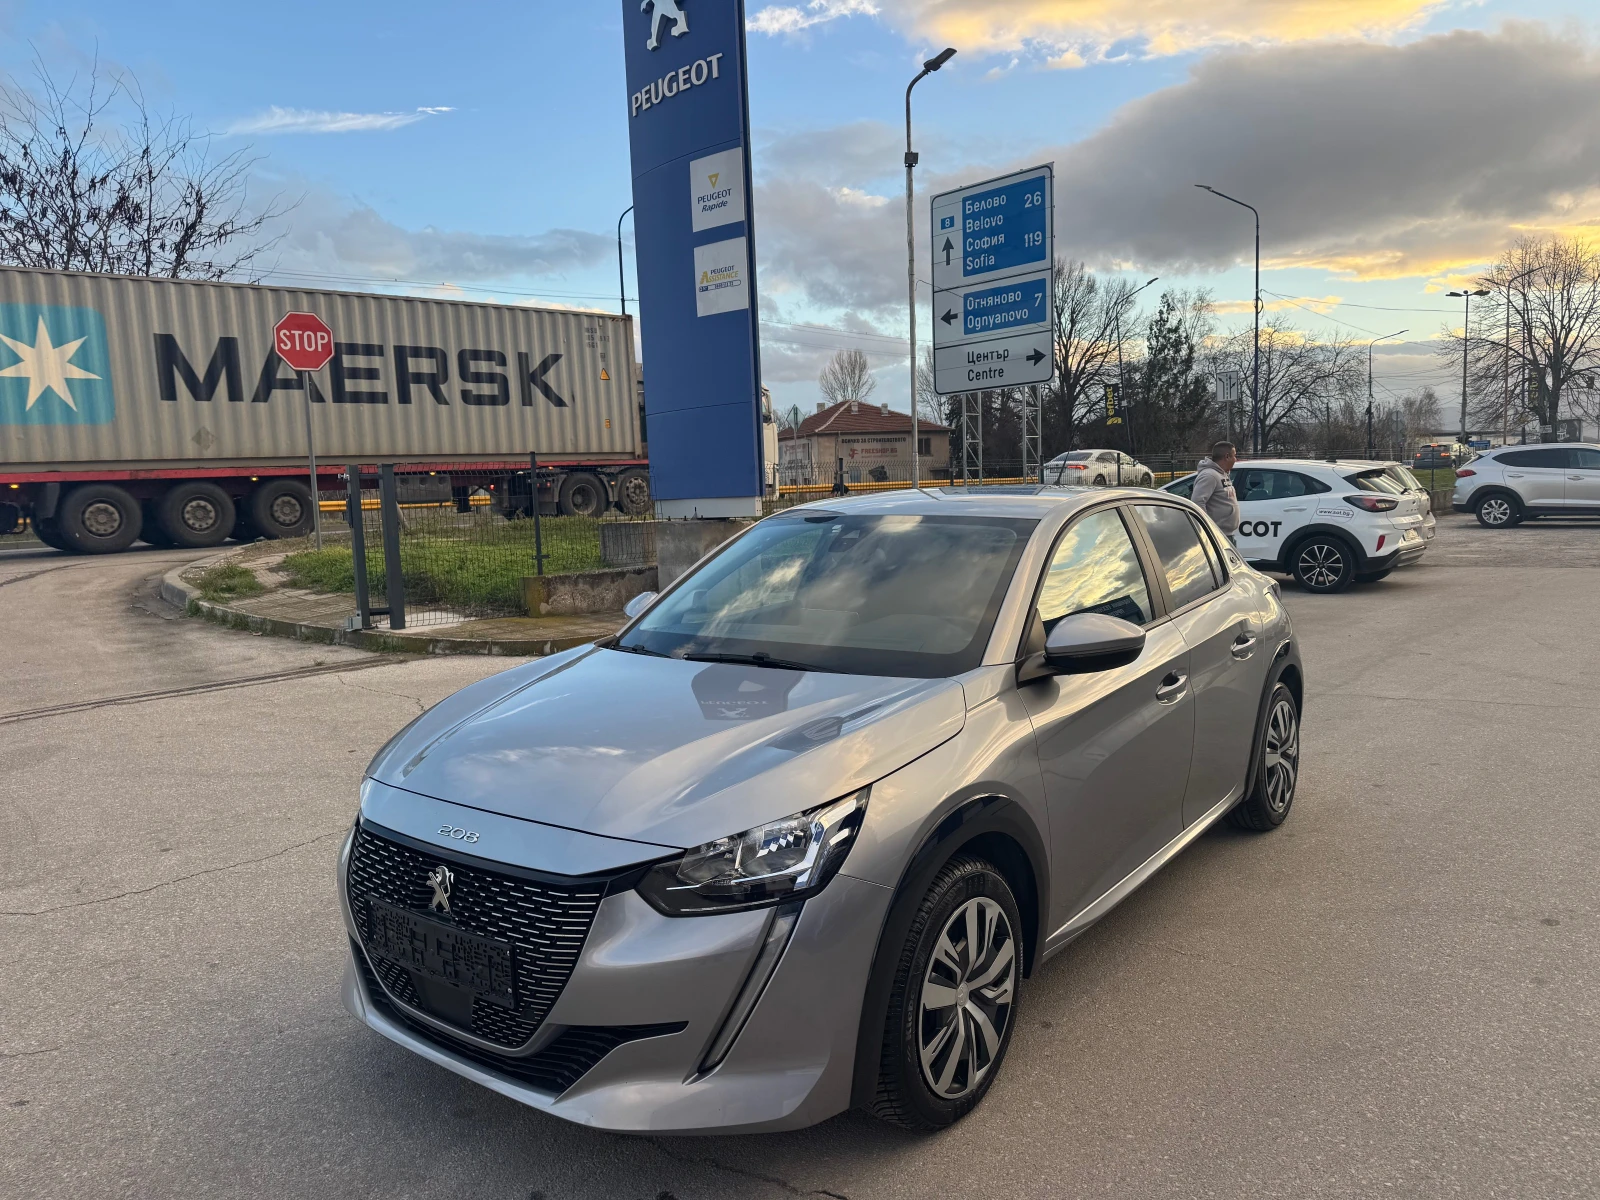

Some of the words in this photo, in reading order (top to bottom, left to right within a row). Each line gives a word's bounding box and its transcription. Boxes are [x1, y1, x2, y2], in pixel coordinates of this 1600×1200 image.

[631, 52, 723, 117] PEUGEOT
[697, 188, 732, 205] PEUGEOT
[701, 200, 728, 212] Rapide
[965, 194, 1006, 213] Белово
[1024, 191, 1042, 208] 26
[944, 218, 951, 228] 8
[966, 214, 1004, 233] Belovo
[966, 234, 1005, 252] София
[1024, 231, 1042, 248] 119
[710, 264, 735, 275] PEUGEOT
[966, 254, 995, 270] Sofia
[699, 270, 739, 285] ASSISTANCE
[967, 291, 1022, 310] Огняново
[1034, 293, 1043, 307] 7
[967, 308, 1029, 331] Ognyanovo
[279, 329, 329, 352] STOP
[967, 348, 1010, 365] Център
[153, 333, 569, 408] MAERSK
[967, 367, 1004, 381] Centre
[1106, 386, 1114, 415] efbet
[437, 824, 480, 843] 208
